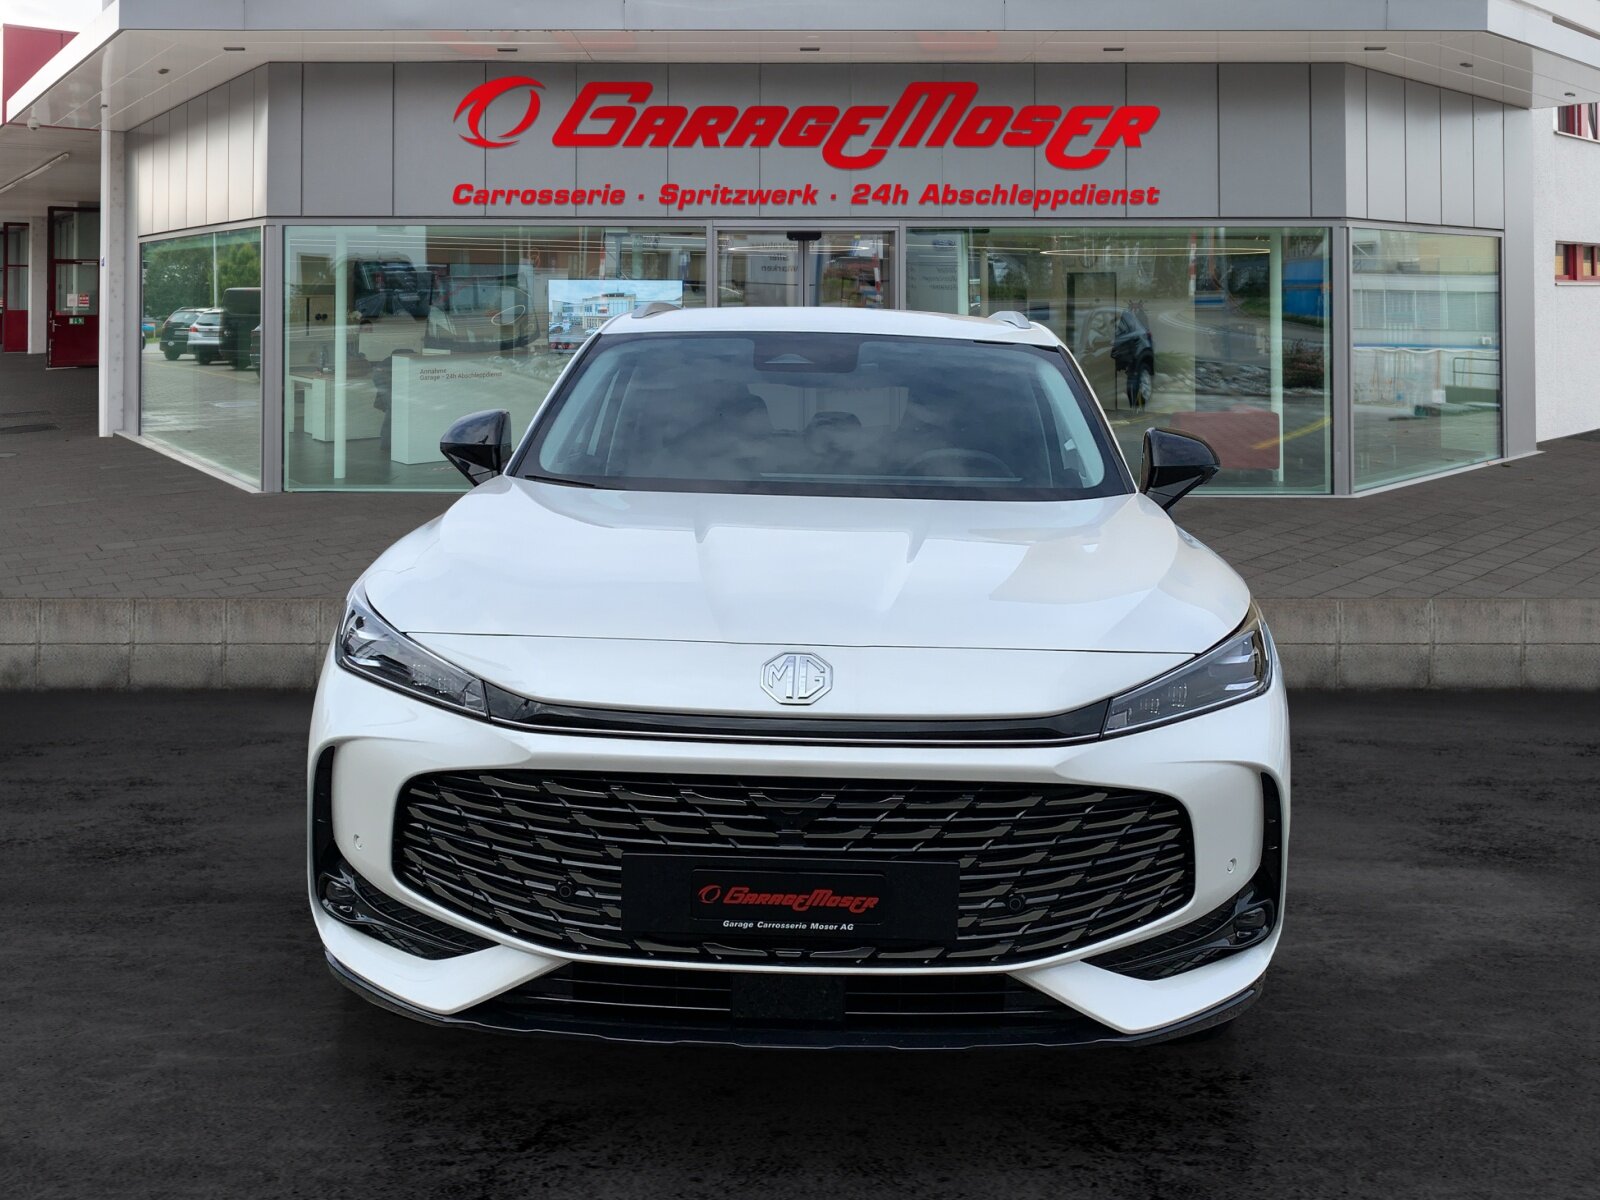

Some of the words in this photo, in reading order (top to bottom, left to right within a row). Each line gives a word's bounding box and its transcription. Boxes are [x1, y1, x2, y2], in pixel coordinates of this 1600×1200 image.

[451, 182, 626, 206] Carrosserie
[657, 182, 819, 211] Spritzwerk
[850, 182, 910, 206] 24h
[917, 182, 1161, 211] Abschleppdienst
[767, 655, 826, 700] MG
[722, 920, 754, 930] Garage
[757, 920, 807, 931] Carrosserie
[810, 922, 838, 931] Moser
[840, 923, 854, 931] AG
